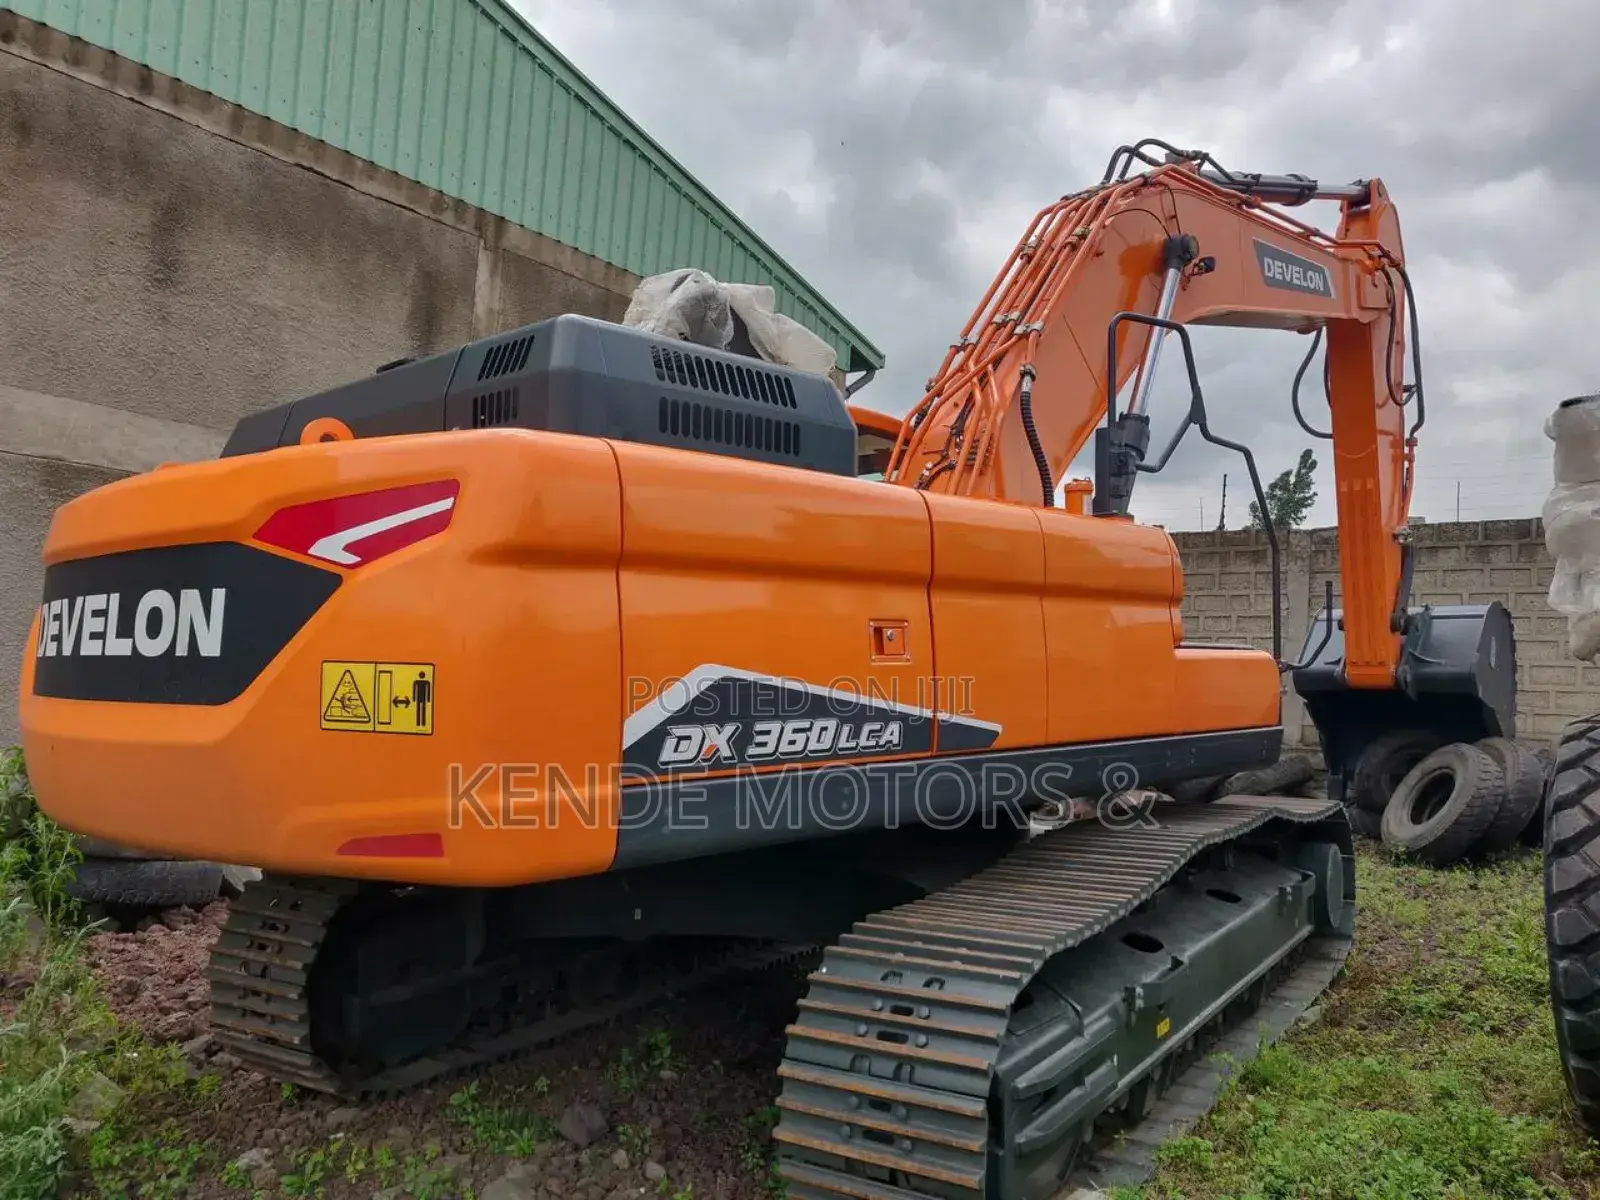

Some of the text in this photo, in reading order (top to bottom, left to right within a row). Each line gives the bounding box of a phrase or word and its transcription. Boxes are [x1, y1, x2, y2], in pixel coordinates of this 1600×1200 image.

[1264, 257, 1324, 291] DEVELON
[36, 588, 226, 657] DEVELON
[658, 724, 742, 768] DX
